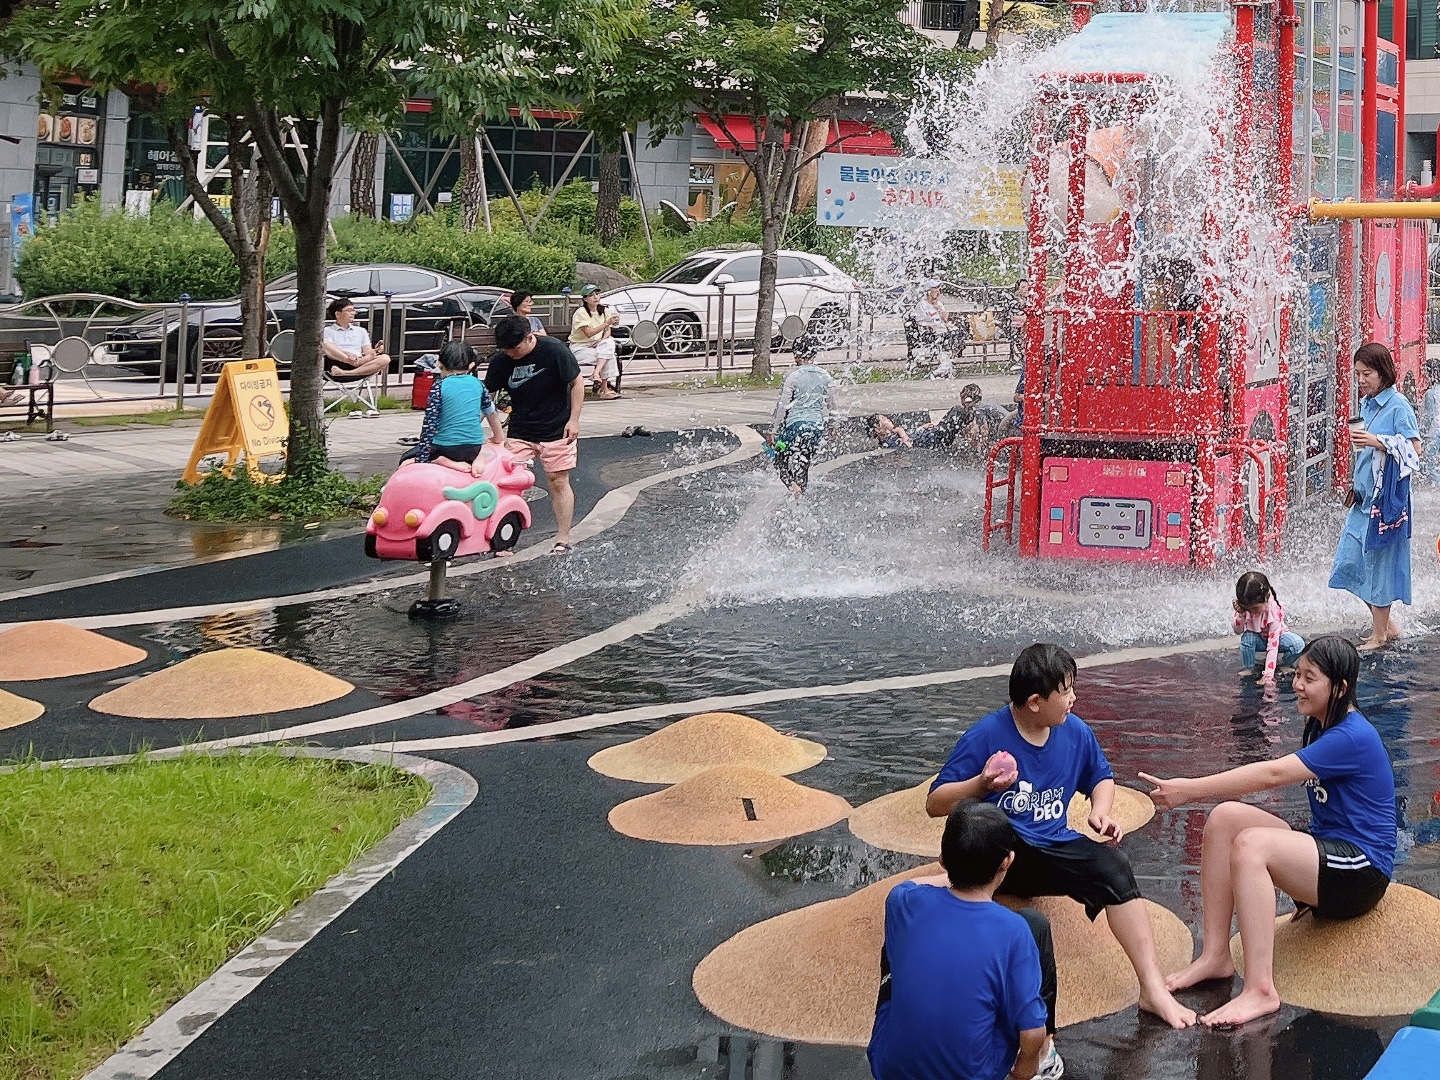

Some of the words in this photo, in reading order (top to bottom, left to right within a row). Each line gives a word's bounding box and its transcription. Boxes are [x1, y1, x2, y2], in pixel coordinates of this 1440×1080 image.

[240, 378, 273, 391] 다이빙금지
[252, 439, 261, 447] No
[1033, 799, 1064, 822] DEO
